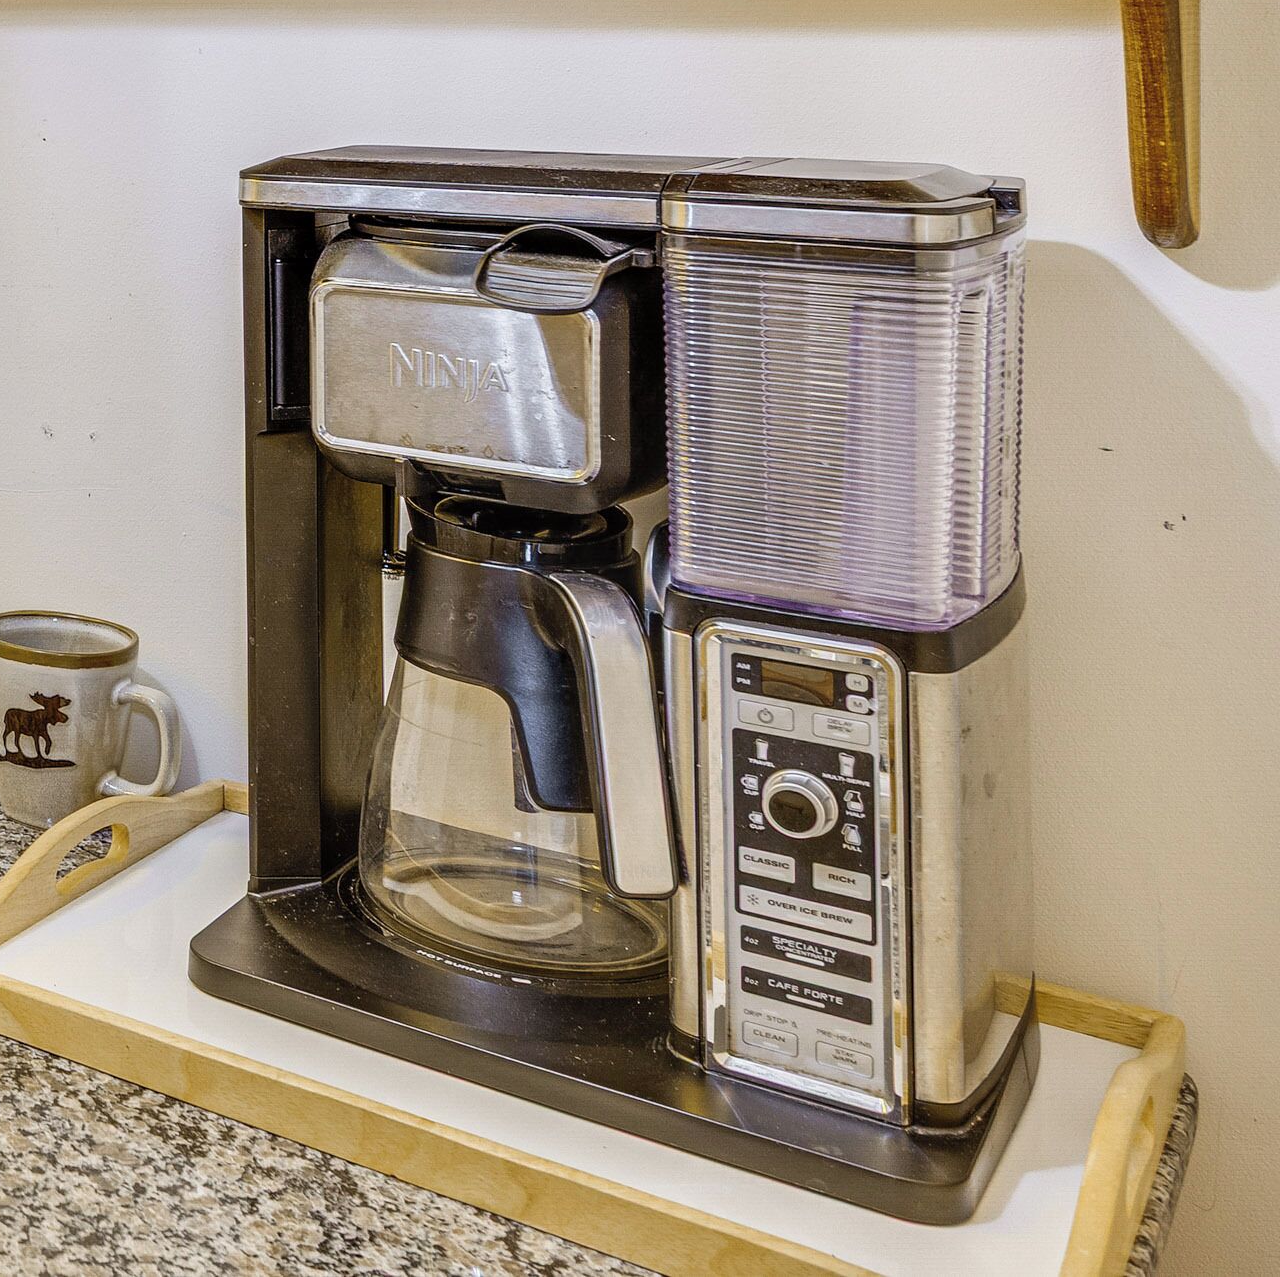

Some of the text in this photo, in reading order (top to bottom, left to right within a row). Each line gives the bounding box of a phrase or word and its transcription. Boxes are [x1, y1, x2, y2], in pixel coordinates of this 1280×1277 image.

[390, 342, 509, 403] NINJA
[736, 662, 751, 671] AM
[736, 677, 751, 685] PM
[827, 718, 852, 727] DELAY
[827, 724, 853, 733] BREW
[748, 757, 775, 768] TRAVEL
[822, 773, 871, 787] MULTI-SERVE
[842, 843, 862, 853] FULL
[744, 854, 790, 870] CLASSIC
[828, 873, 856, 885] RICH
[768, 900, 853, 924] OVER ICE BREW
[772, 936, 837, 958] SPECIALTY
[775, 944, 835, 964] CONCENTRATED
[416, 949, 501, 978] HOT SURFACE
[745, 977, 759, 986] 8oz
[768, 978, 844, 1005] CAFE FORTE
[767, 1014, 788, 1024] STOP
[753, 1028, 786, 1043] CLEAN
[816, 1028, 872, 1049] PRE-HEATING
[835, 1049, 854, 1057] STAY
[833, 1054, 857, 1065] WARM
